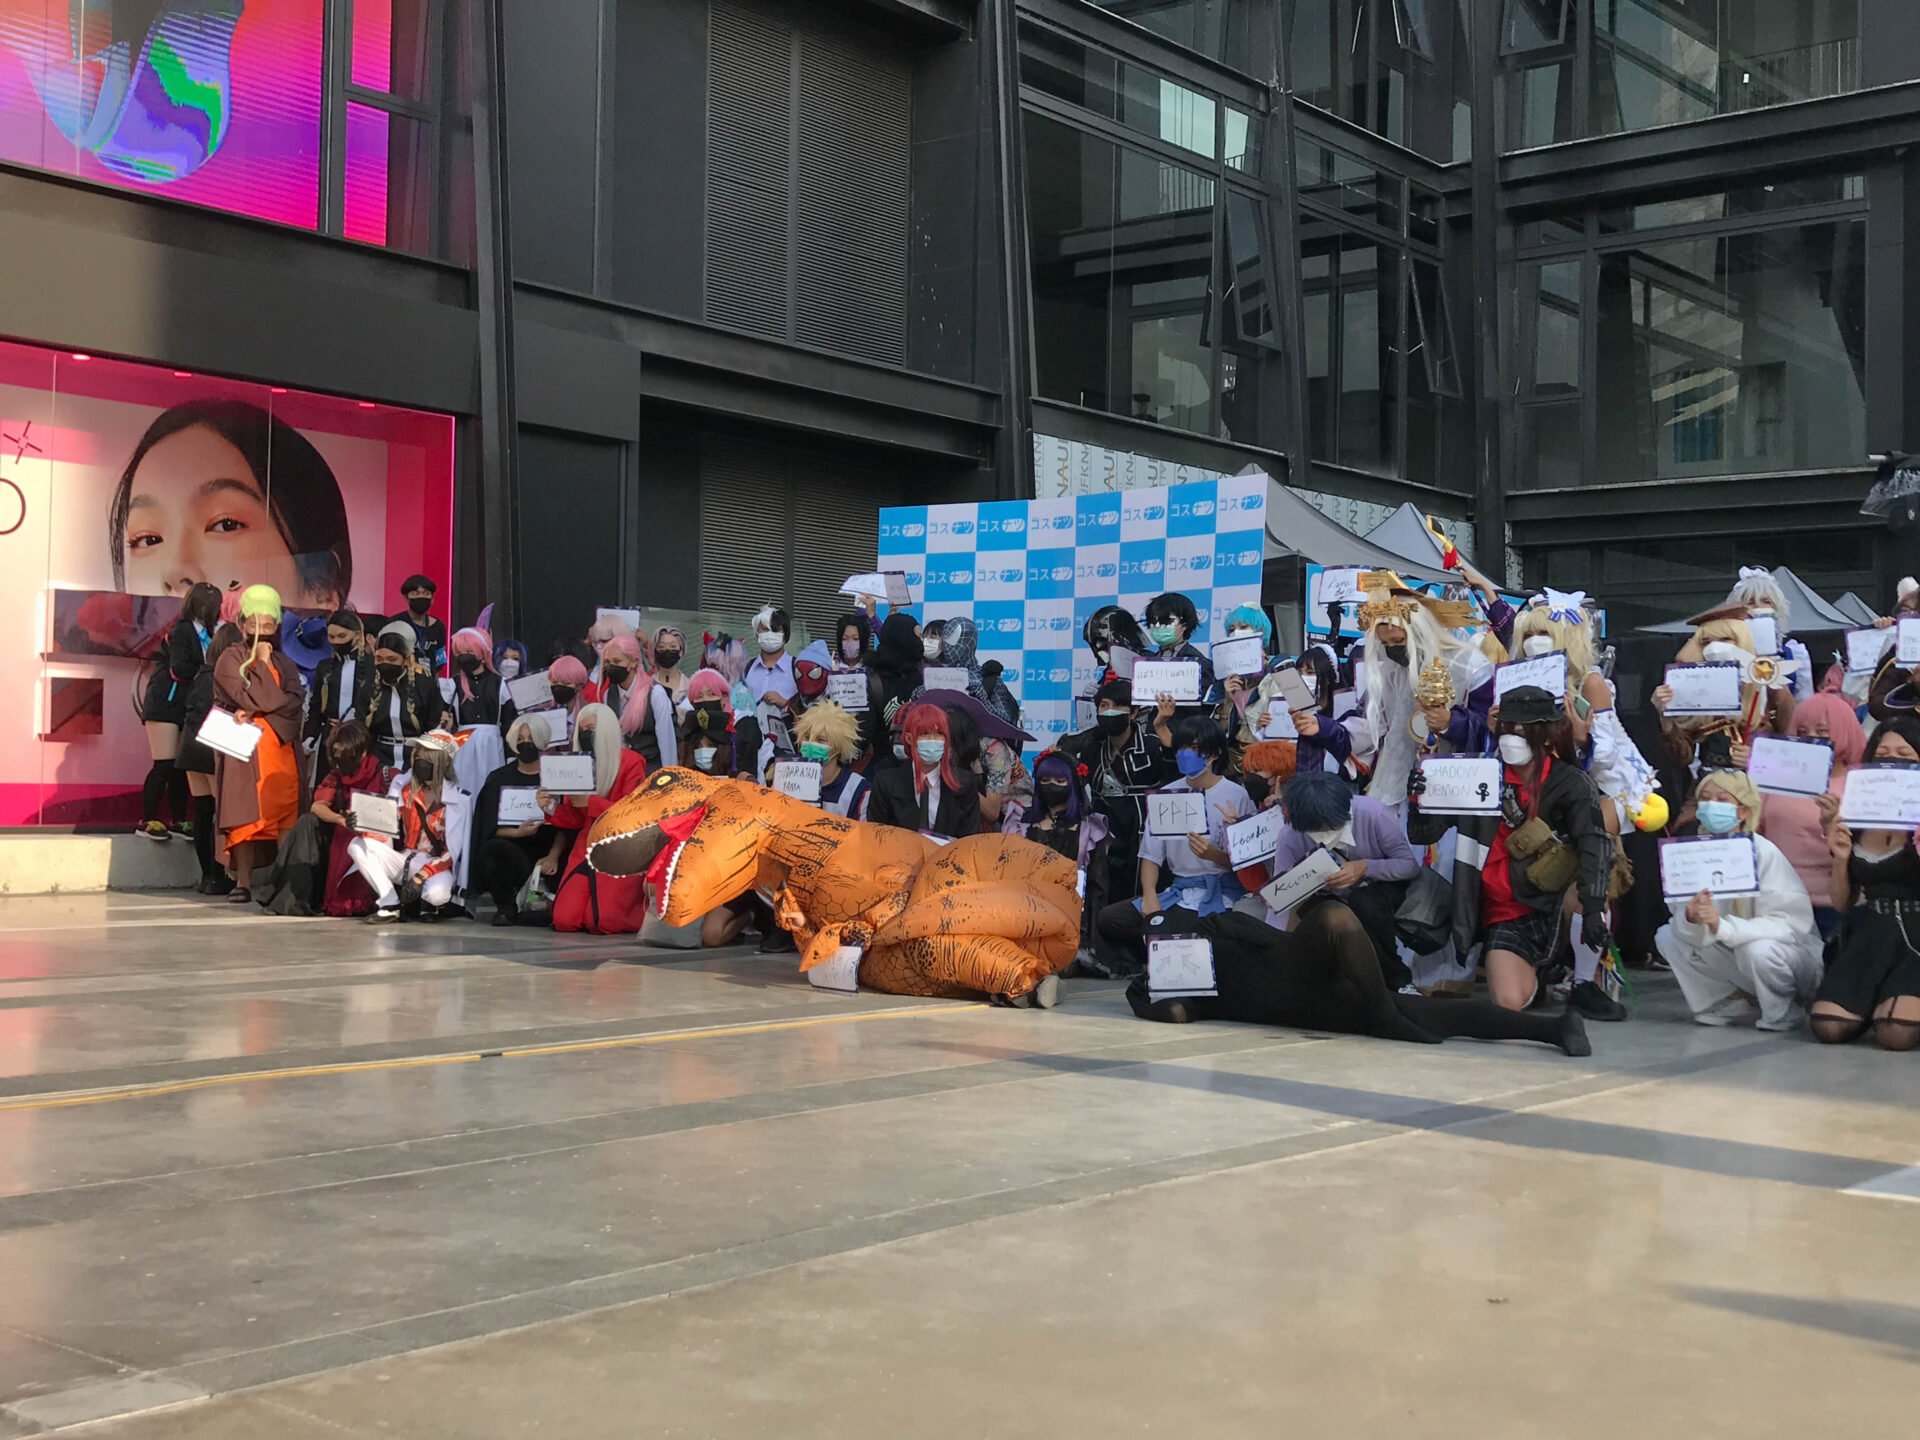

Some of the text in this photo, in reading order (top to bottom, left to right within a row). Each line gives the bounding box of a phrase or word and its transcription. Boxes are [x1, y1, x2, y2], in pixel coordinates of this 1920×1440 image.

[1171, 500, 1214, 517] コスナツ
[1219, 495, 1263, 511] コスナツ
[1078, 511, 1119, 526] コスナツ
[1123, 506, 1165, 521] コスナツ
[929, 521, 974, 534] コスナツ
[980, 519, 1025, 532] コスナツ
[1031, 516, 1073, 530] コスナツ
[881, 524, 924, 537] コスナツ
[1169, 555, 1211, 571] コスナツ
[1216, 550, 1260, 566] コスナツ
[1077, 563, 1117, 577] コスナツ
[1121, 559, 1163, 574] コスナツ
[927, 571, 972, 584] コスナツ
[977, 569, 1023, 582] コスナツ
[1029, 567, 1073, 581] コスナツ
[976, 618, 1022, 632] コスナツ
[1028, 617, 1071, 631] コスナツ
[1026, 668, 1070, 682] コスナツ
[1024, 719, 1068, 733] コスナツ
[1429, 765, 1478, 777] SHADOW
[1428, 783, 1471, 797] DEMON
